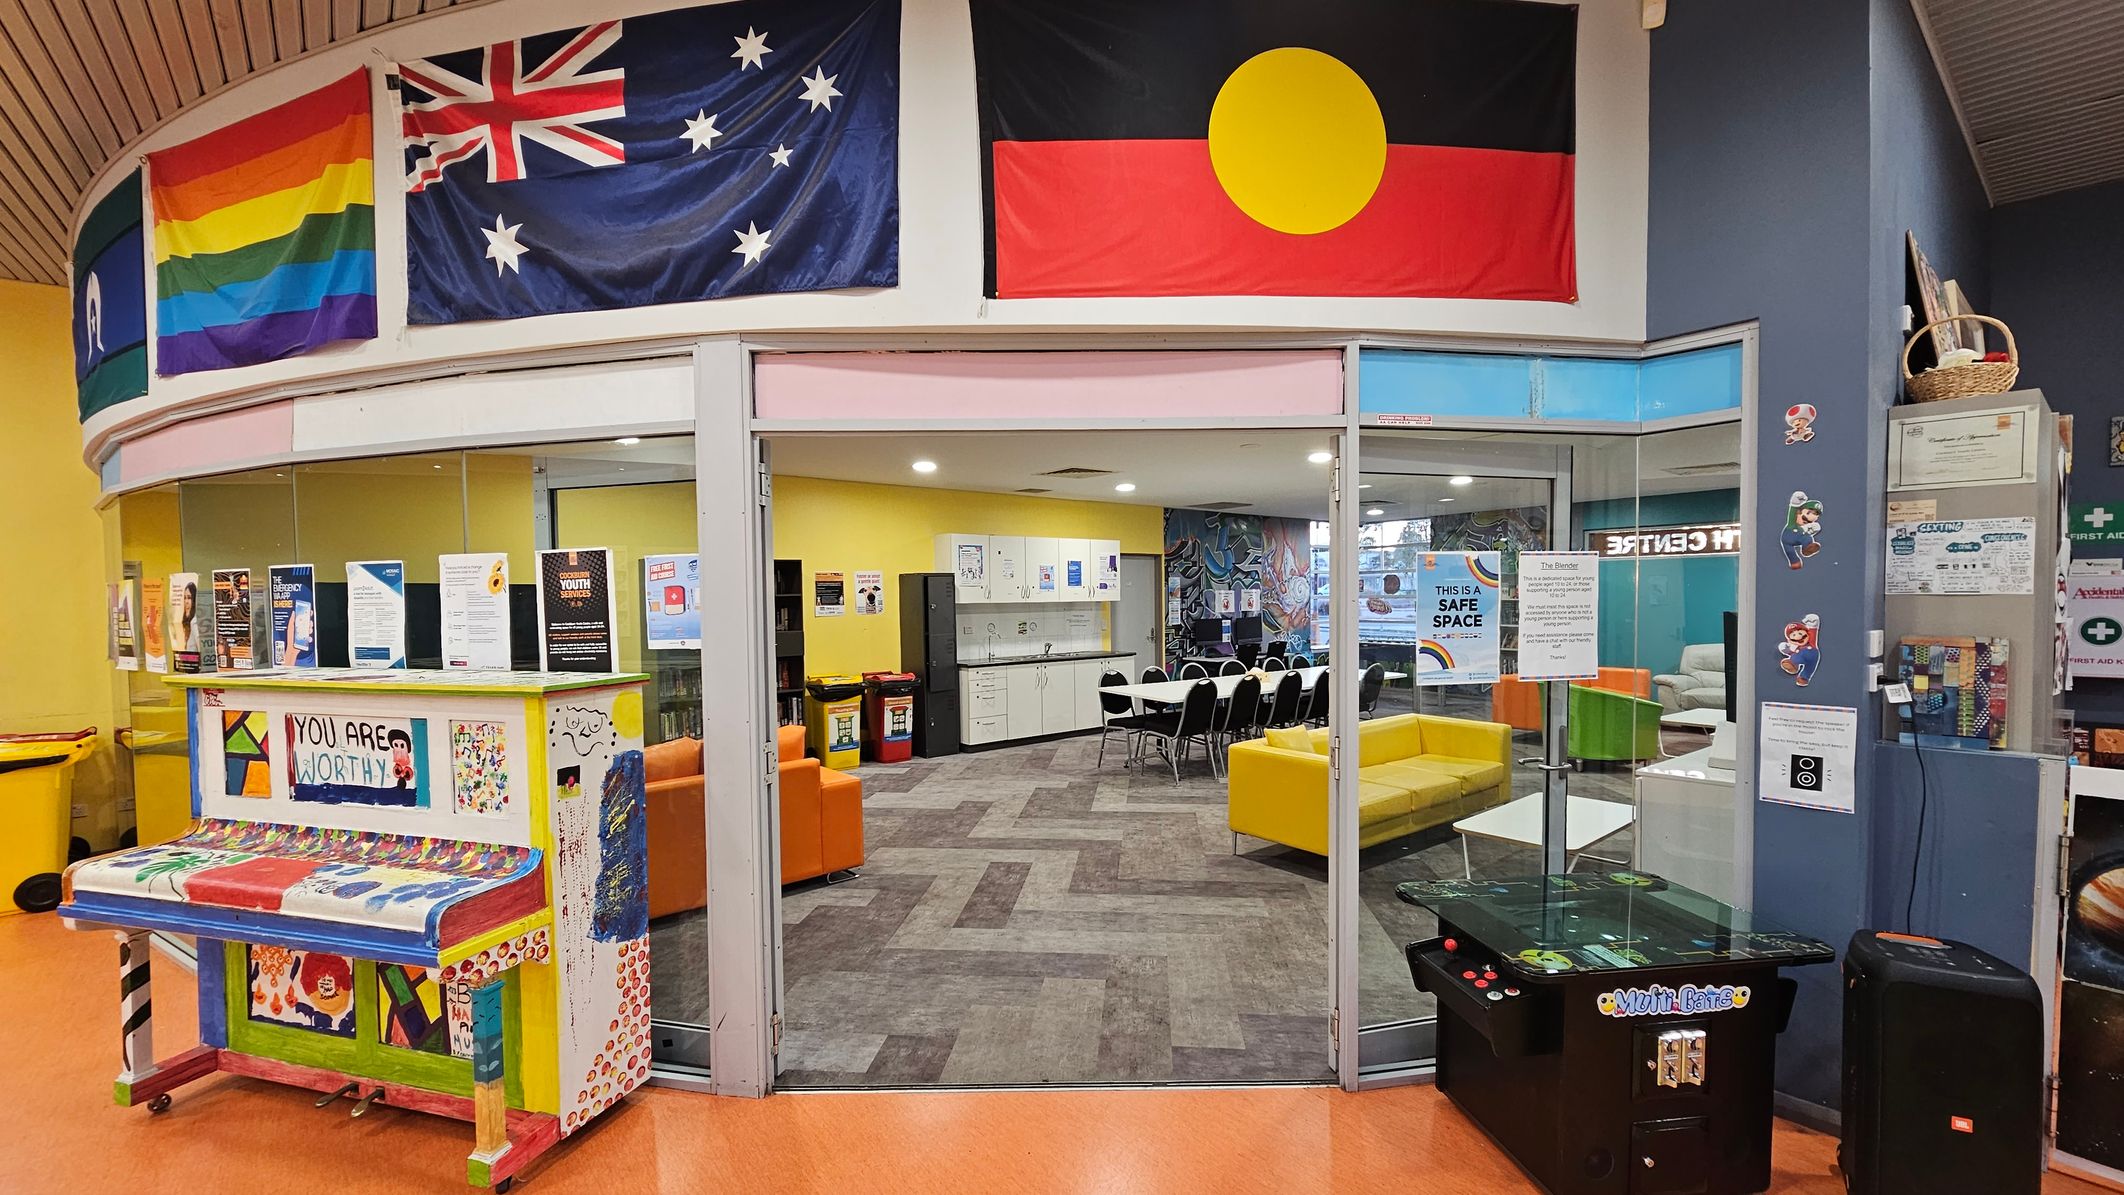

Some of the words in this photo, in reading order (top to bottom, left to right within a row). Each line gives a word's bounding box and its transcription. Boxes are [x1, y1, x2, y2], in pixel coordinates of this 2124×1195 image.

[2070, 532, 2103, 540] FIRST
[273, 584, 302, 592] EMERGENCY
[560, 579, 590, 590] YOUTH
[1436, 586, 1458, 595] THIS
[1462, 586, 1471, 594] IS
[1473, 586, 1481, 594] A
[560, 590, 591, 598] SERVICES
[2073, 587, 2124, 599] Accidental
[1439, 599, 1478, 612] SAFE
[1433, 615, 1482, 628] SPACE
[294, 716, 336, 748] YOU
[346, 722, 390, 750] ARE
[294, 750, 386, 787] WORTHY
[1614, 986, 1676, 1014] Multi
